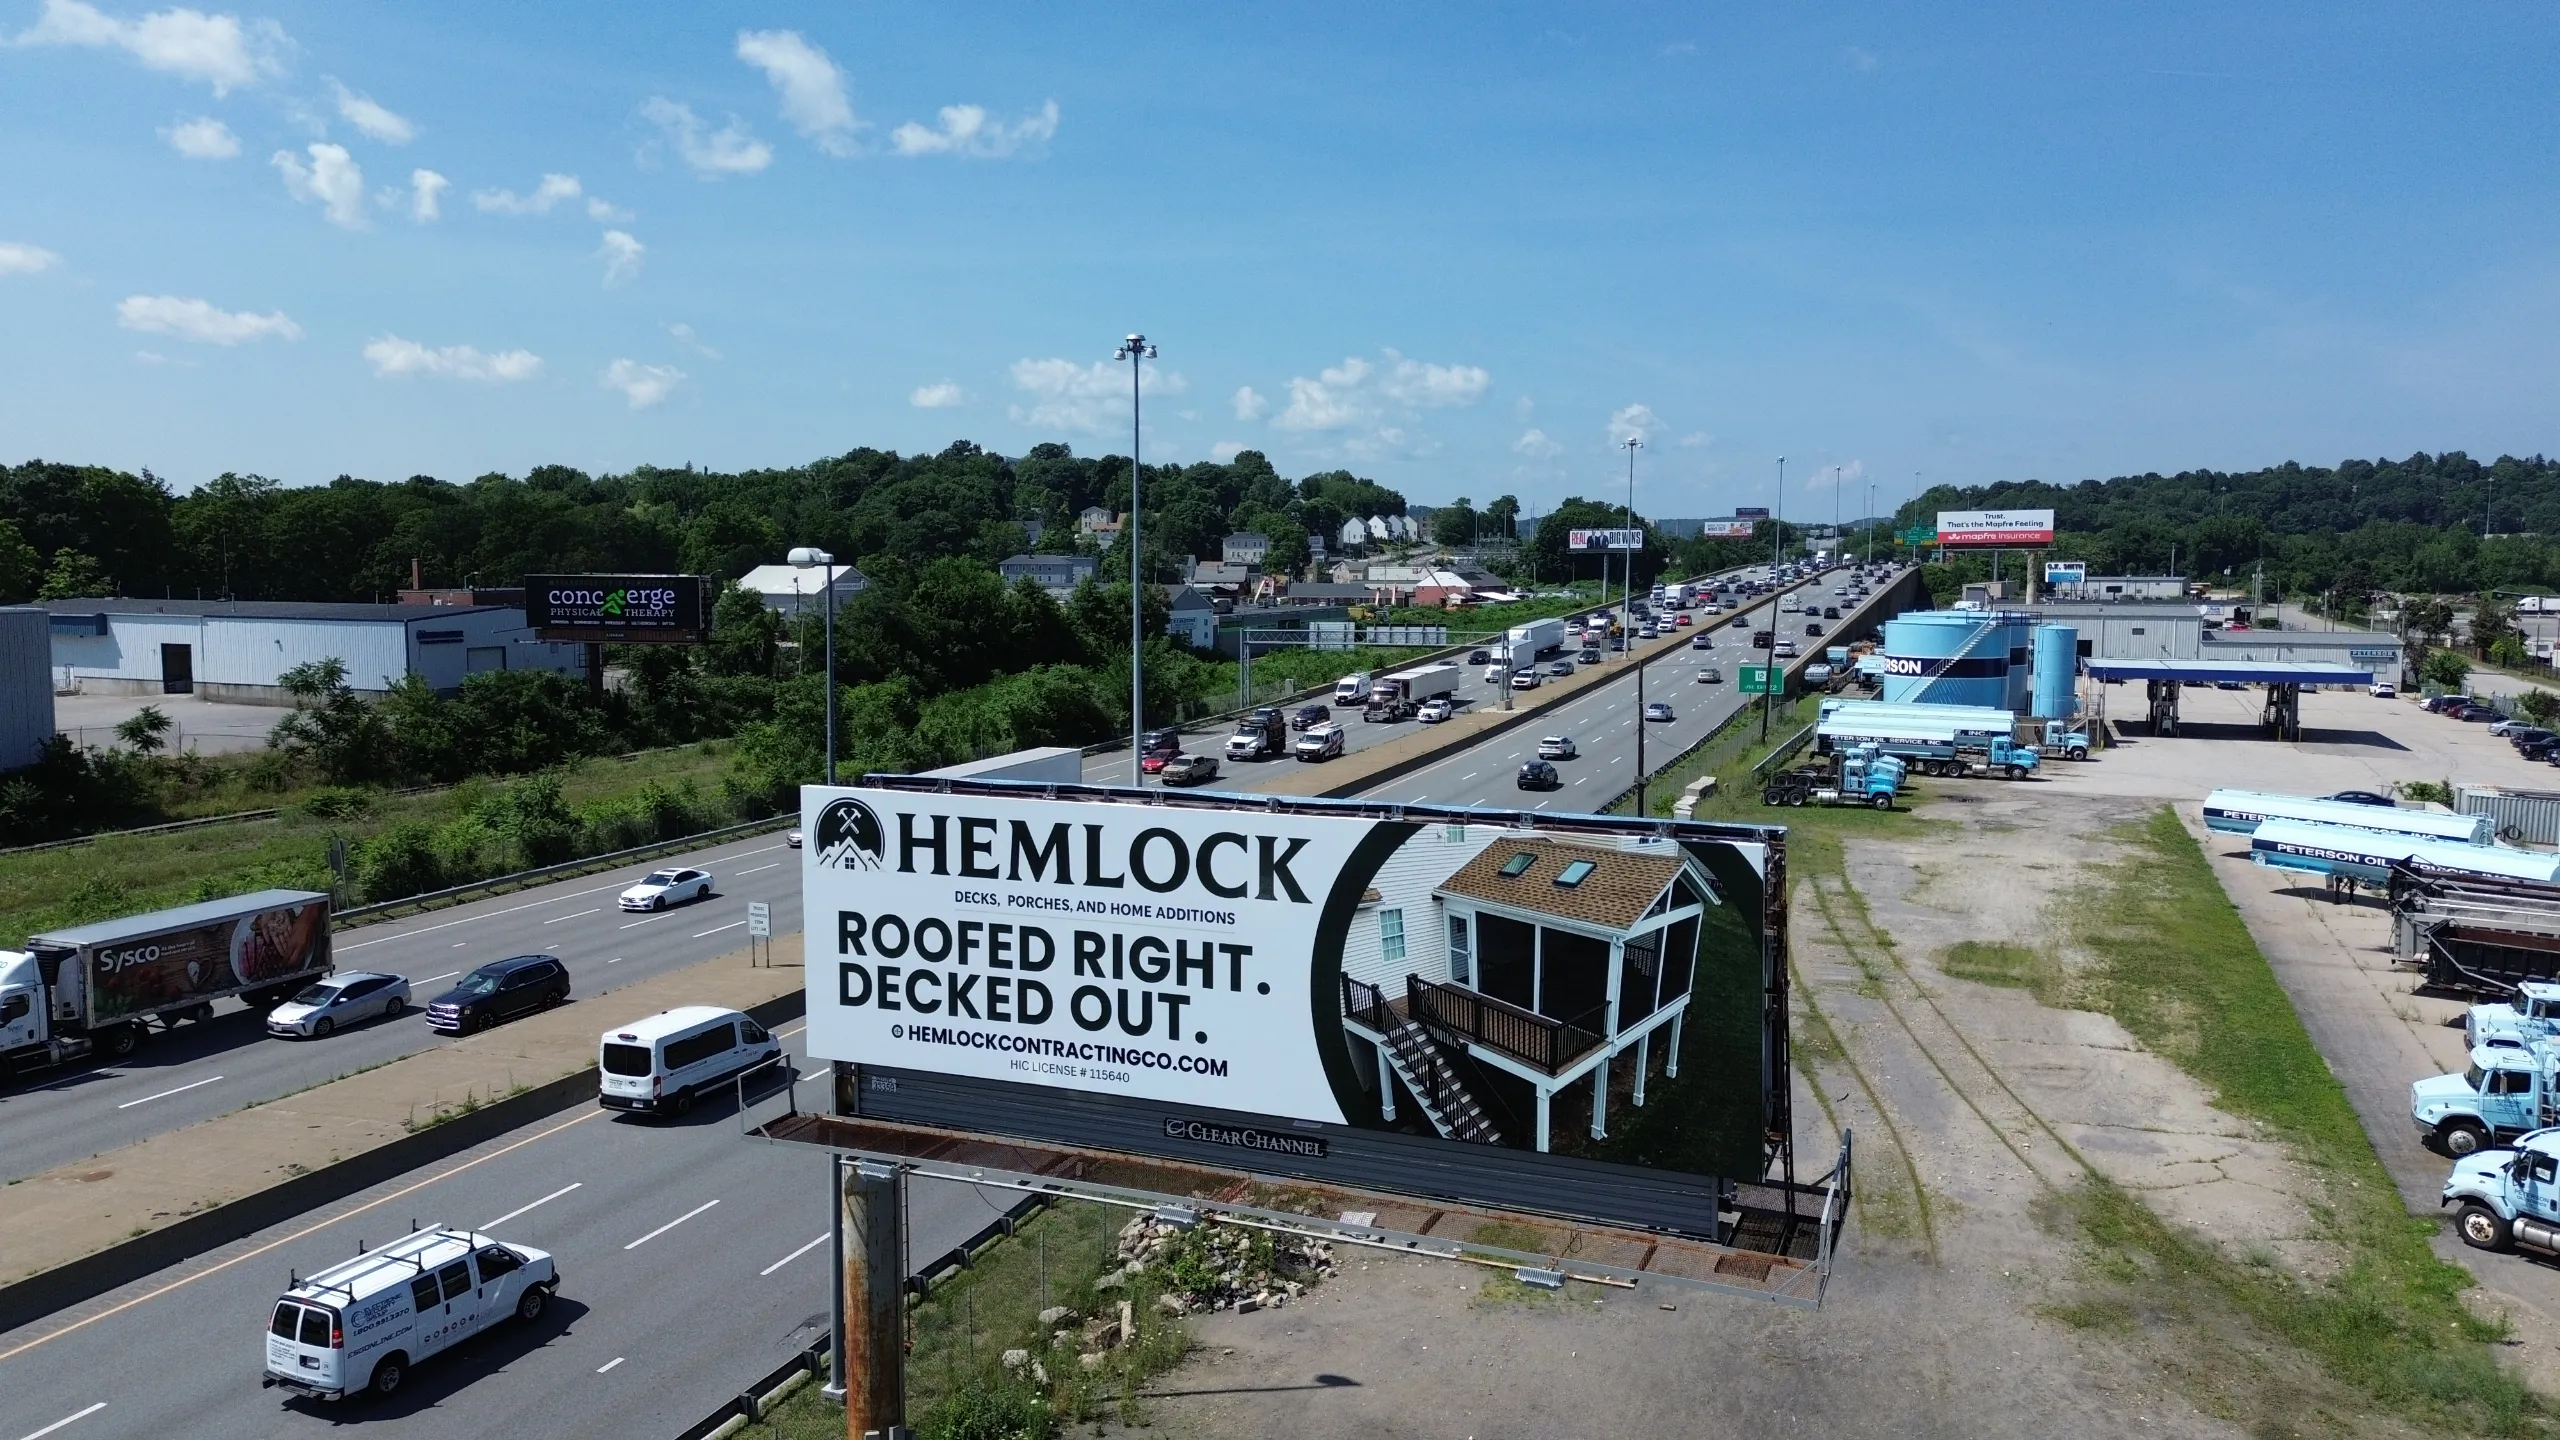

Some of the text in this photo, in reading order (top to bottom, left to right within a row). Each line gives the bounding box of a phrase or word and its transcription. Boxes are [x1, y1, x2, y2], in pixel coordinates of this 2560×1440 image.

[1961, 532, 1997, 541] mapfre
[1985, 520, 2014, 529] Mapfre
[2015, 519, 2044, 528] Feeling
[1571, 531, 1586, 545] REAL
[1609, 531, 1621, 545] BIG
[2063, 563, 2084, 571] SMITH
[550, 608, 675, 617] PHYSICAL THERAPY
[1757, 672, 1765, 680] 12
[896, 812, 1313, 904] HEMLOCK
[2276, 842, 2392, 868] PETERSON OIL
[954, 890, 1236, 925] DECKS, PORCHES, AND HOME ADDITIONS
[838, 910, 1271, 996] ROOFED RIGHT.
[839, 962, 1208, 1045] DECKED OUT.
[908, 1024, 1228, 1077] HEMLOCKCONTRACTINGCO.COM
[1010, 1059, 1130, 1084] HIC LICENSE # 115640
[364, 1300, 396, 1317] SECURITY
[347, 1324, 413, 1359] ESGONLINE.COM
